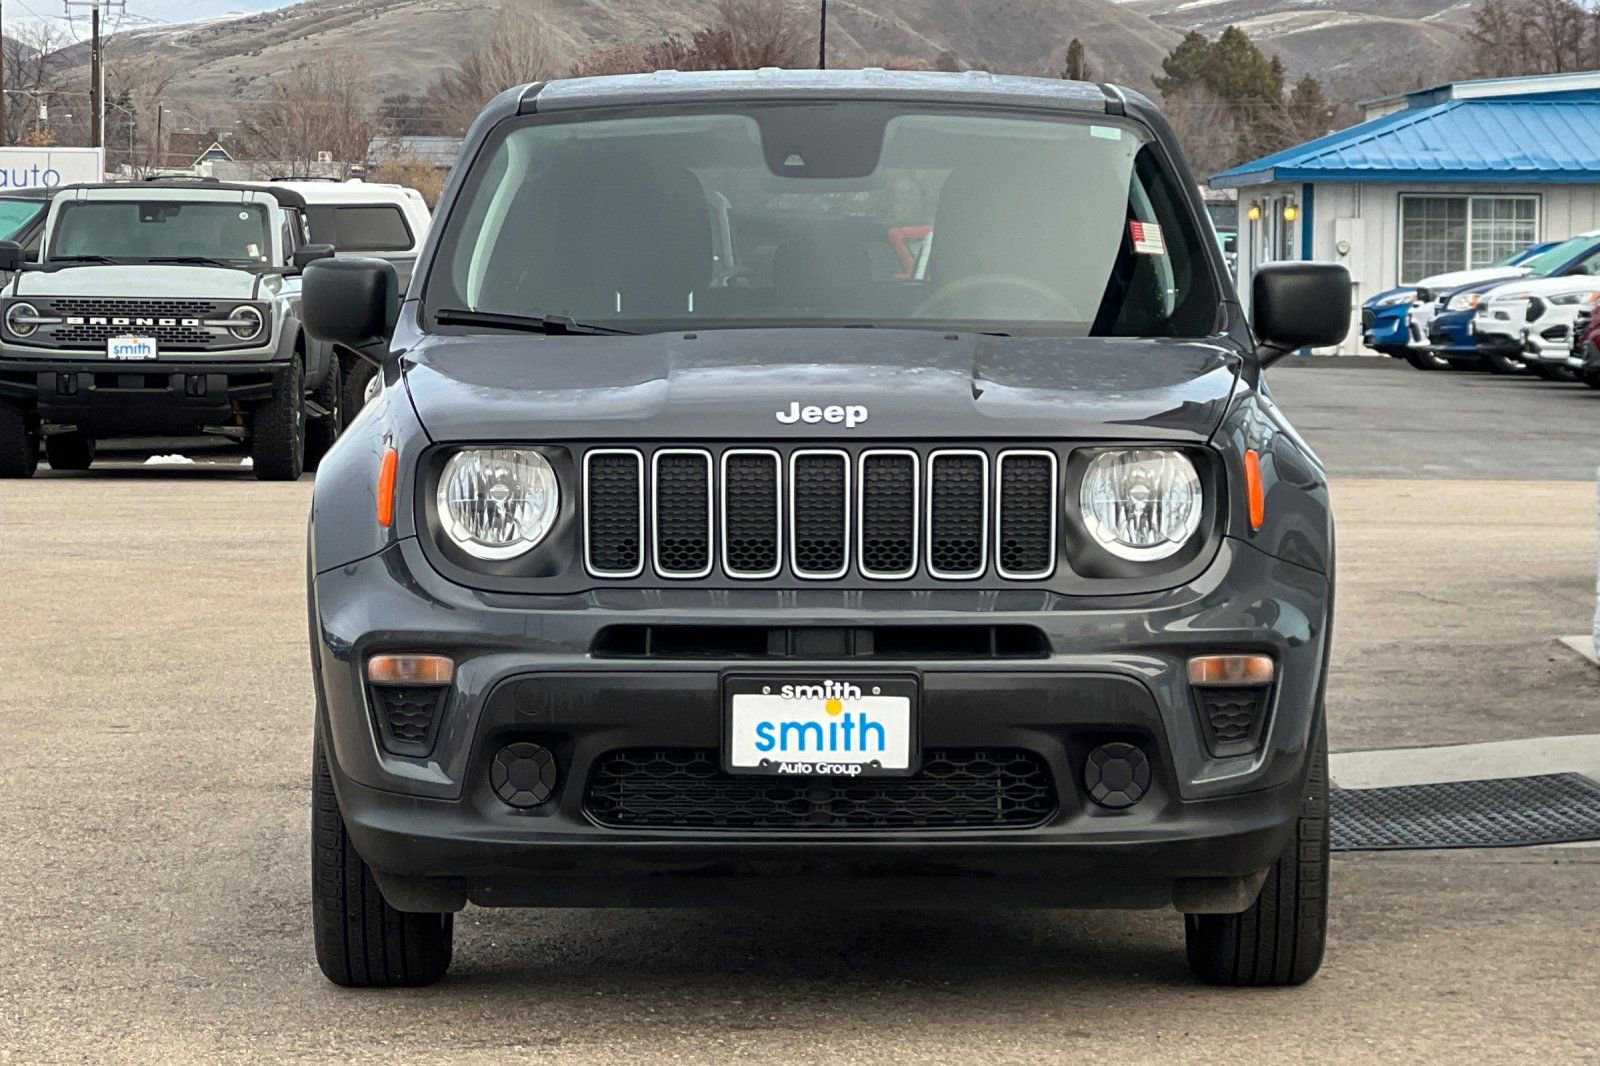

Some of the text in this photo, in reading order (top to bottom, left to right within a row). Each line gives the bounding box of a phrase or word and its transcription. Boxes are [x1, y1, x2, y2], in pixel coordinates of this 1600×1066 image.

[67, 317, 199, 326] BRONCO
[113, 339, 151, 355] smith
[775, 402, 868, 428] Jeep
[781, 680, 861, 700] smith
[755, 698, 885, 752] smith
[778, 762, 861, 777] Auto Group
